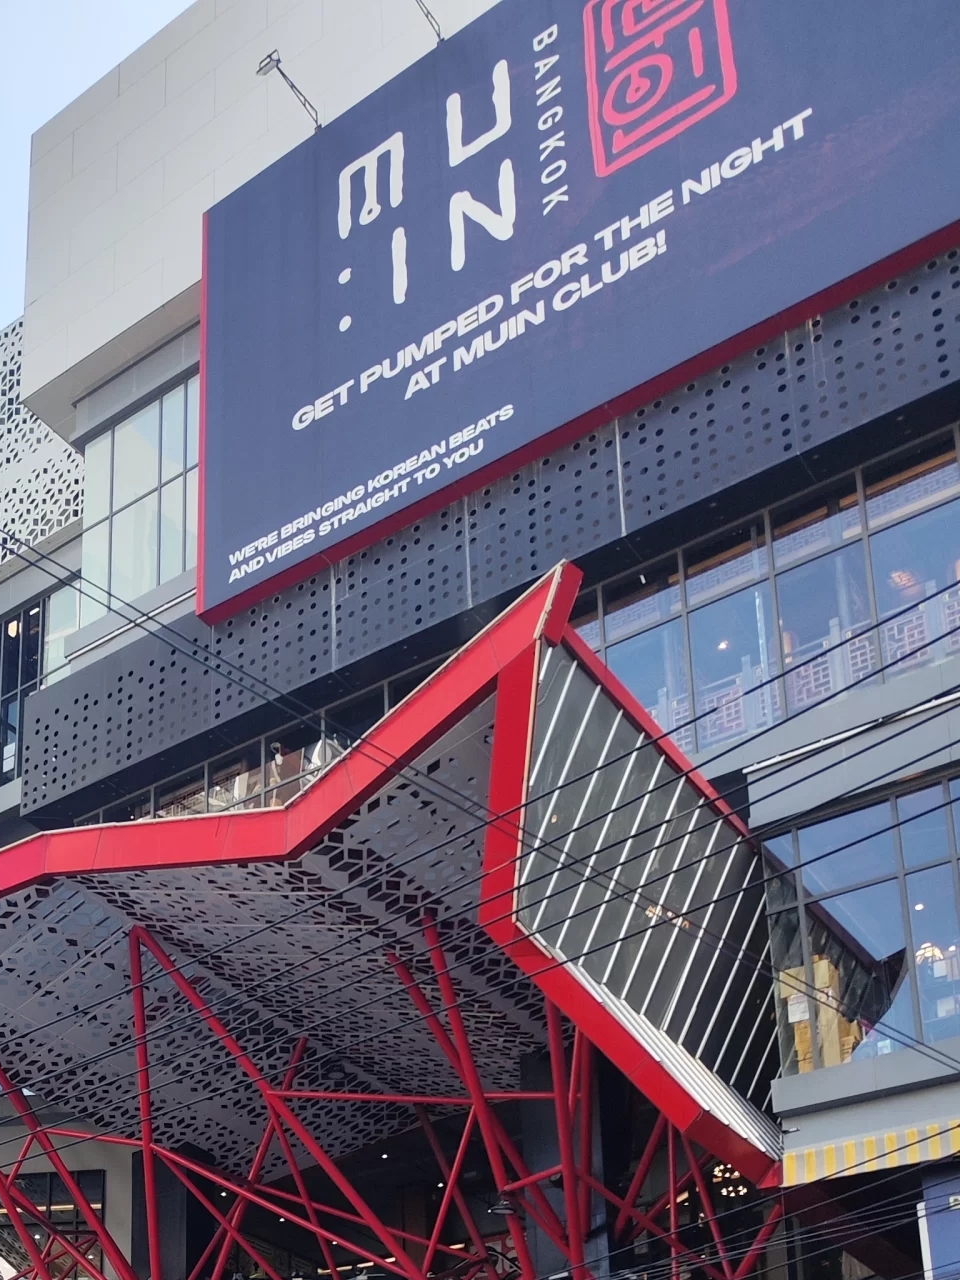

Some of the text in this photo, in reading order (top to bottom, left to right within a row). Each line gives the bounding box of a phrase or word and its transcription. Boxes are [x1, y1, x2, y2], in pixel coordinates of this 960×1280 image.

[533, 24, 568, 216] BANGKOK
[292, 108, 813, 431] GET PUMPED FOR THE NIGHT
[405, 230, 668, 400] AT MUIN CLUB!
[229, 404, 514, 566] WE'RE BRINGING KOREAN BEATS
[229, 438, 485, 584] AND VIBES STRAIGHT TO YOU
